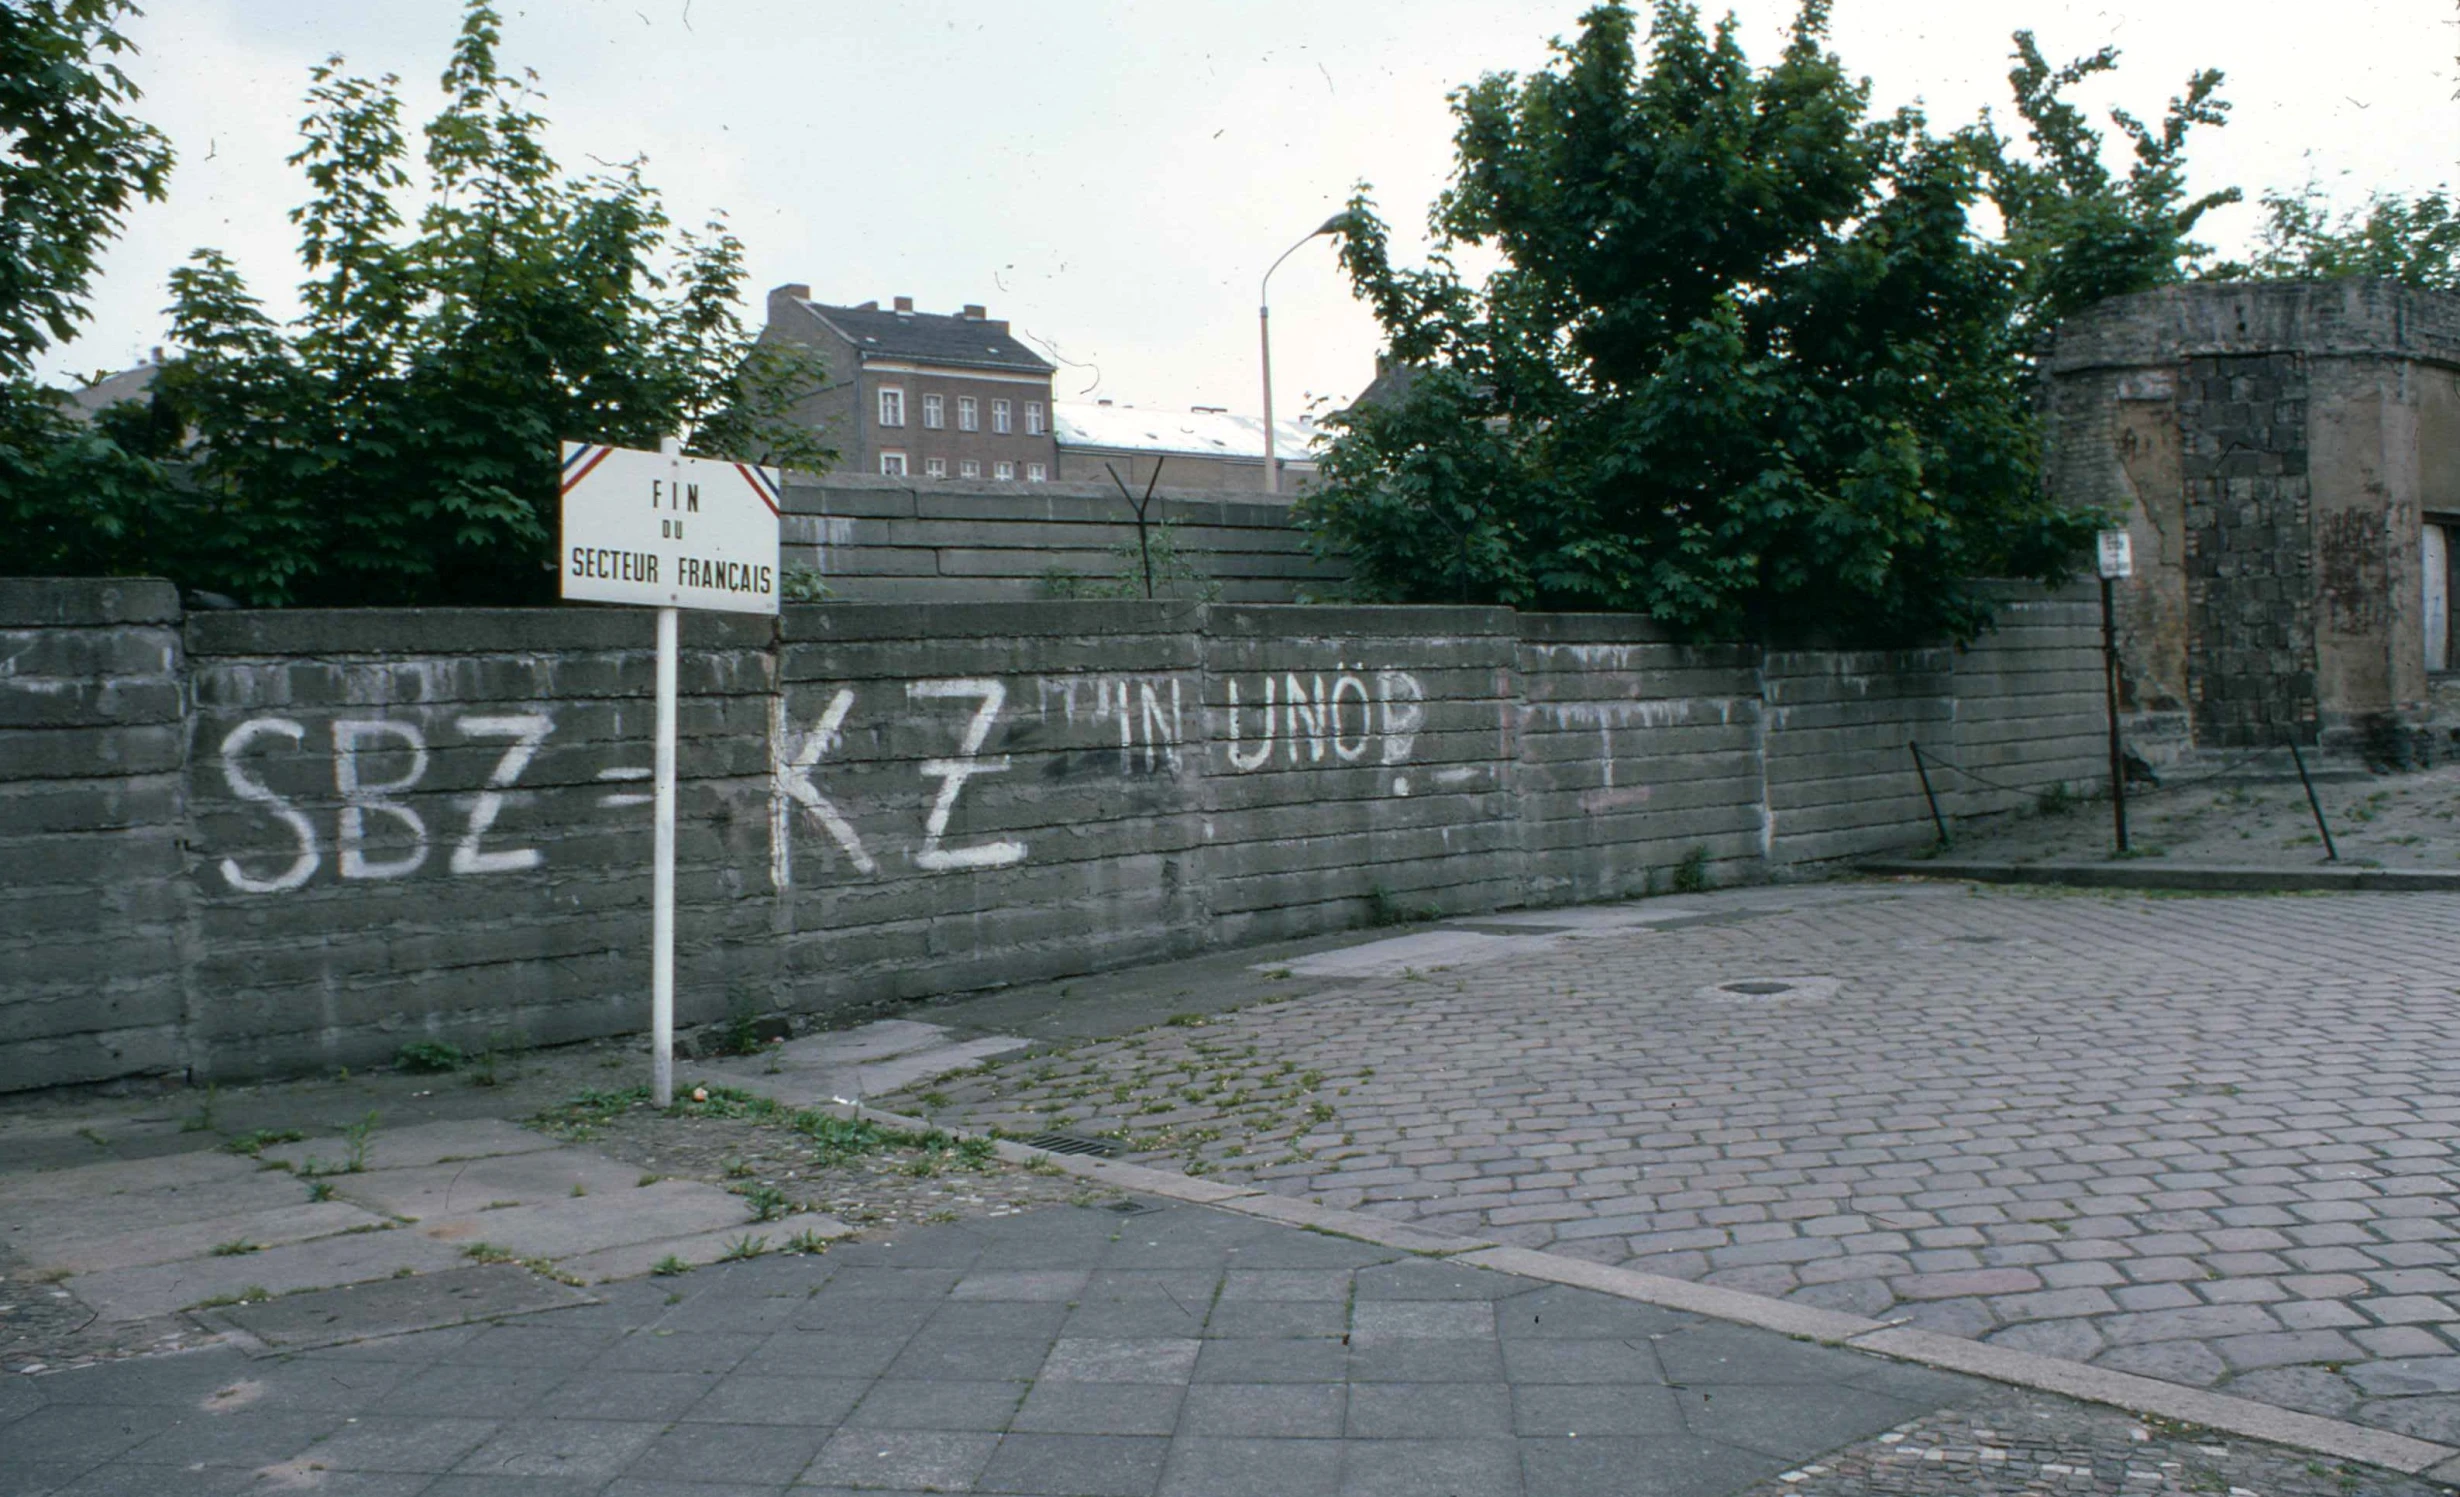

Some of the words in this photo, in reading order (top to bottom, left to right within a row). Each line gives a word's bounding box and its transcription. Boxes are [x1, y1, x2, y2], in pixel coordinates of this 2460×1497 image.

[652, 479, 699, 513] FIN
[661, 519, 683, 540] DU
[571, 547, 659, 584] SECTEUR
[678, 557, 772, 595] FRANÇAIS
[218, 714, 556, 894] SBZ
[767, 677, 1028, 890] KZ
